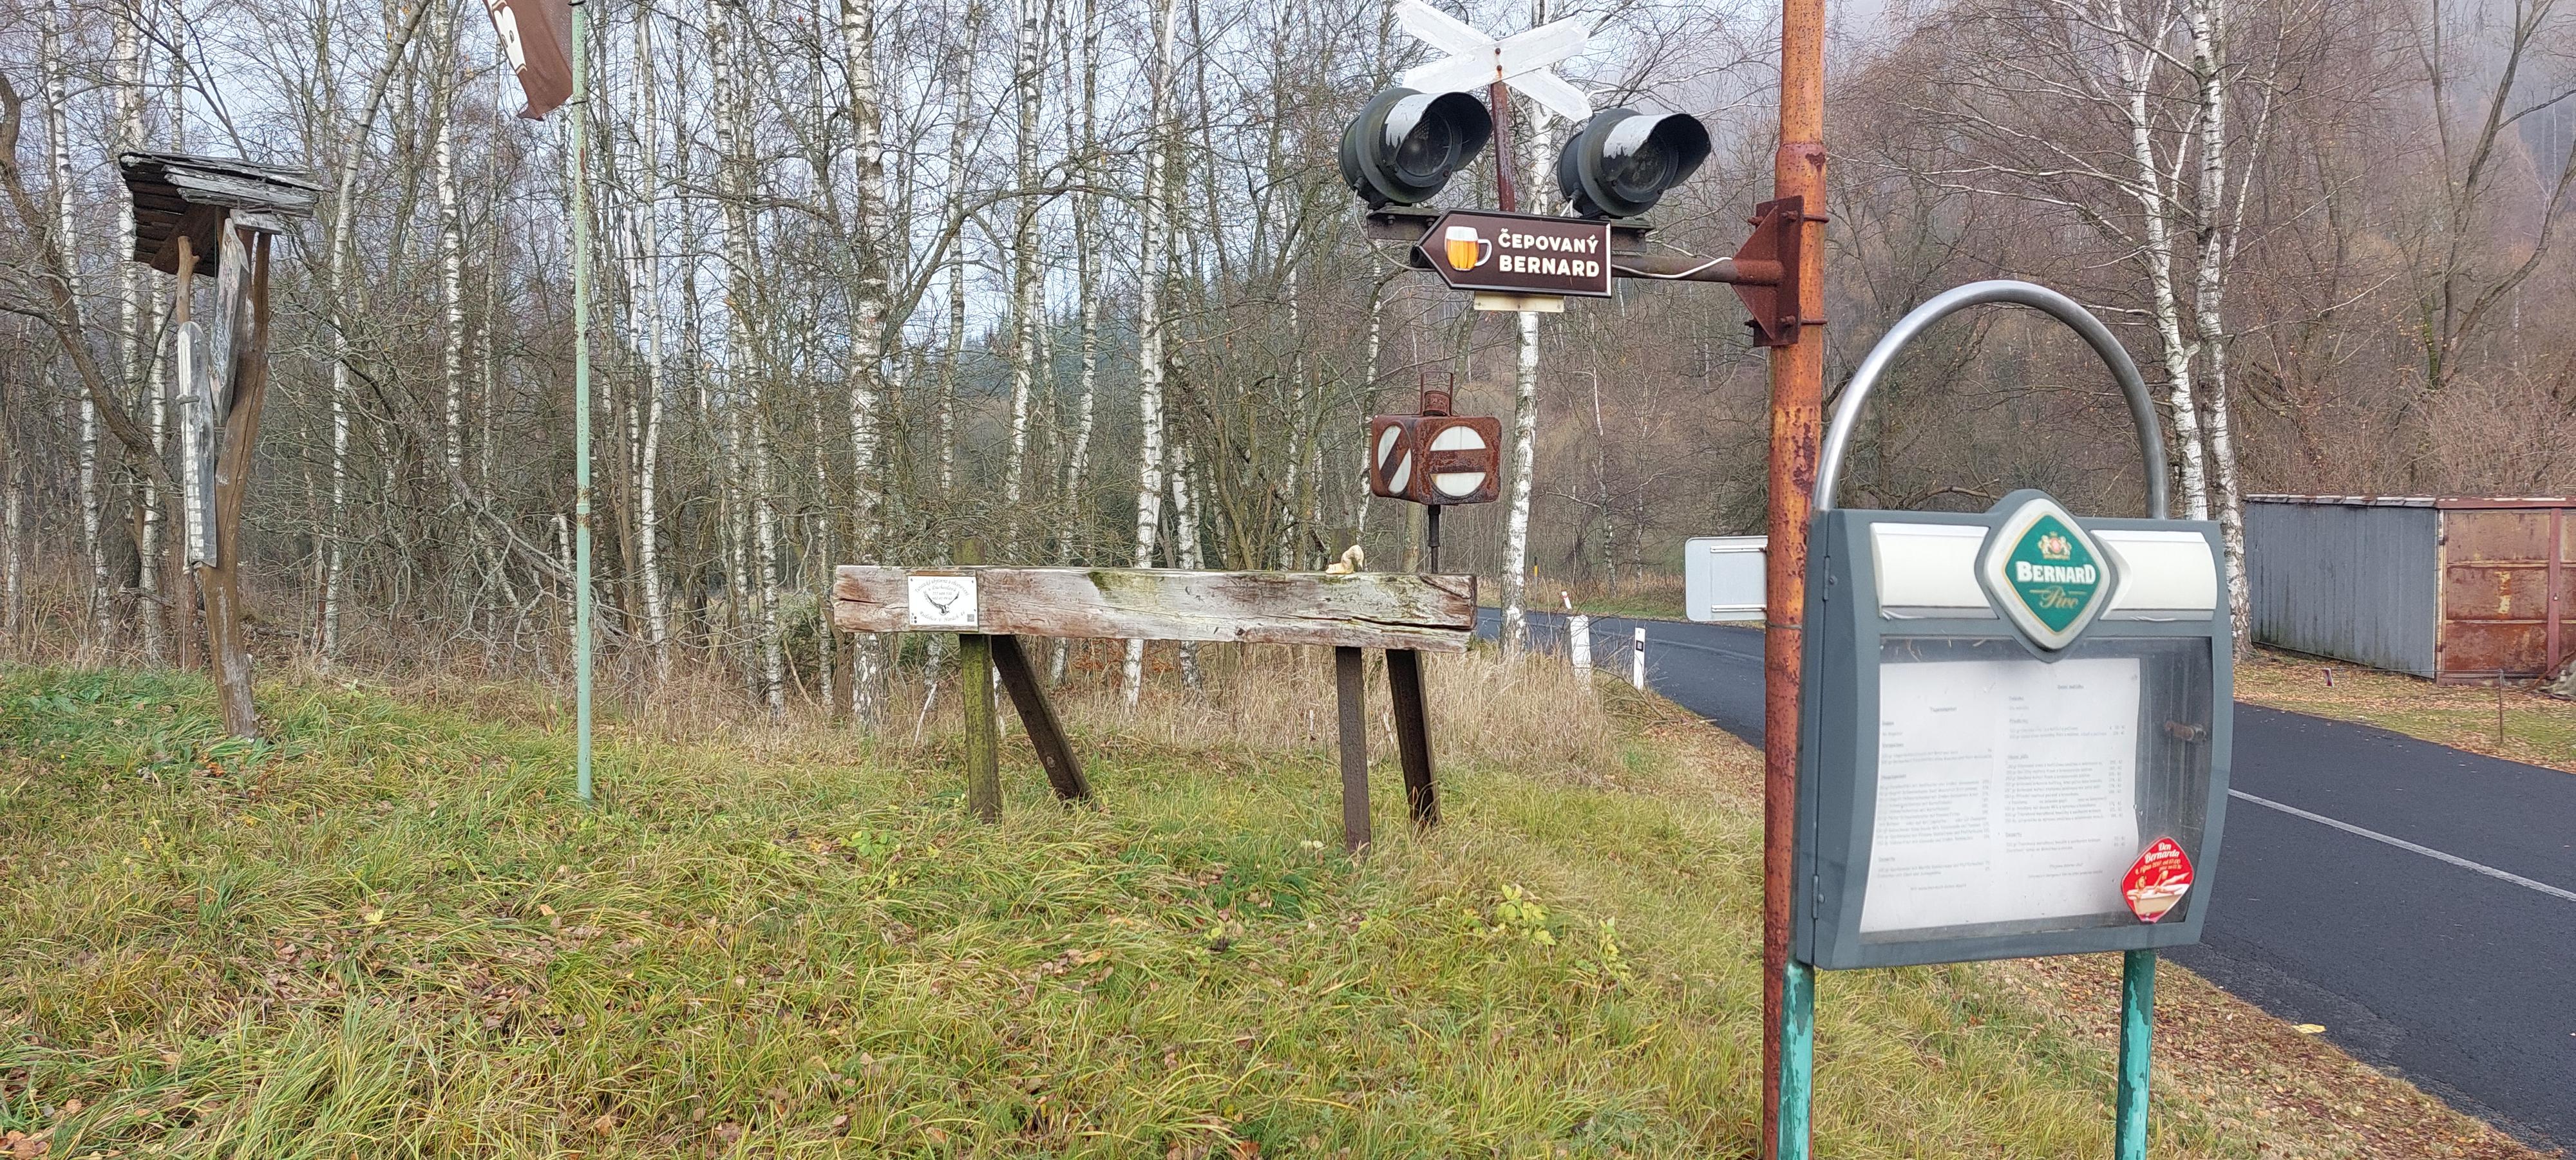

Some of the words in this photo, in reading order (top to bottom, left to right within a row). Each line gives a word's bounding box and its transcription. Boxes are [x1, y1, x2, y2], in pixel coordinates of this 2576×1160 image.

[1498, 228, 1599, 254] ČEPOVANÝ
[1499, 254, 1600, 278] BERNARD
[2015, 561, 2097, 585] BERNARD
[2145, 849, 2180, 864] Bernarda
[2158, 842, 2172, 851] Den
